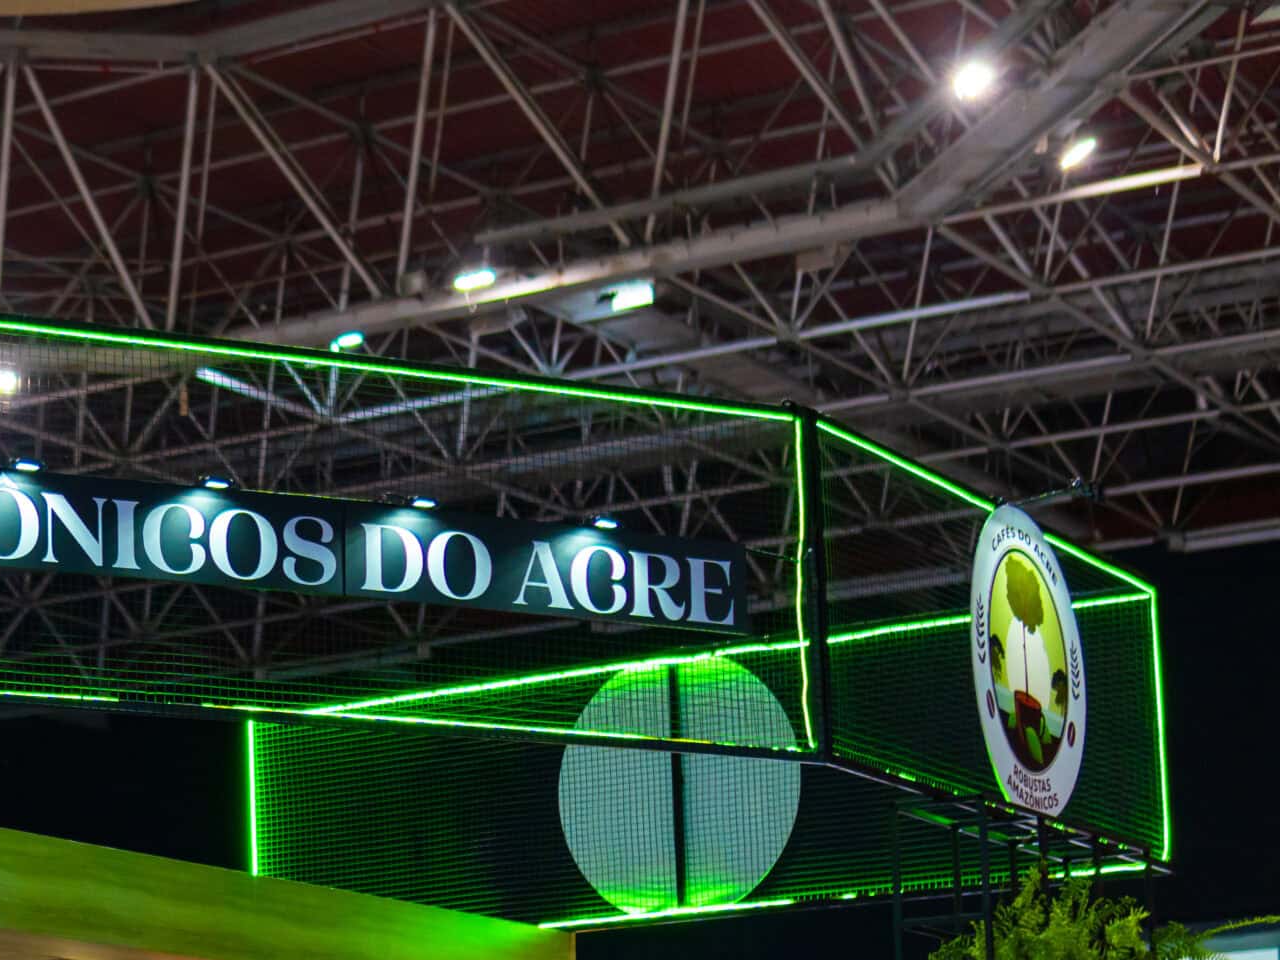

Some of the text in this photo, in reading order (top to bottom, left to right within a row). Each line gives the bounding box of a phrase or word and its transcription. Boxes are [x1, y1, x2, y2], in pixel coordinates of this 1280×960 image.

[360, 523, 492, 601] DO
[512, 541, 735, 626] ACRE
[992, 524, 1058, 587] CAFÉS DO ACRE
[1007, 774, 1060, 810] AMAZÔNICOS
[1013, 763, 1052, 793] ROBUSTAS
